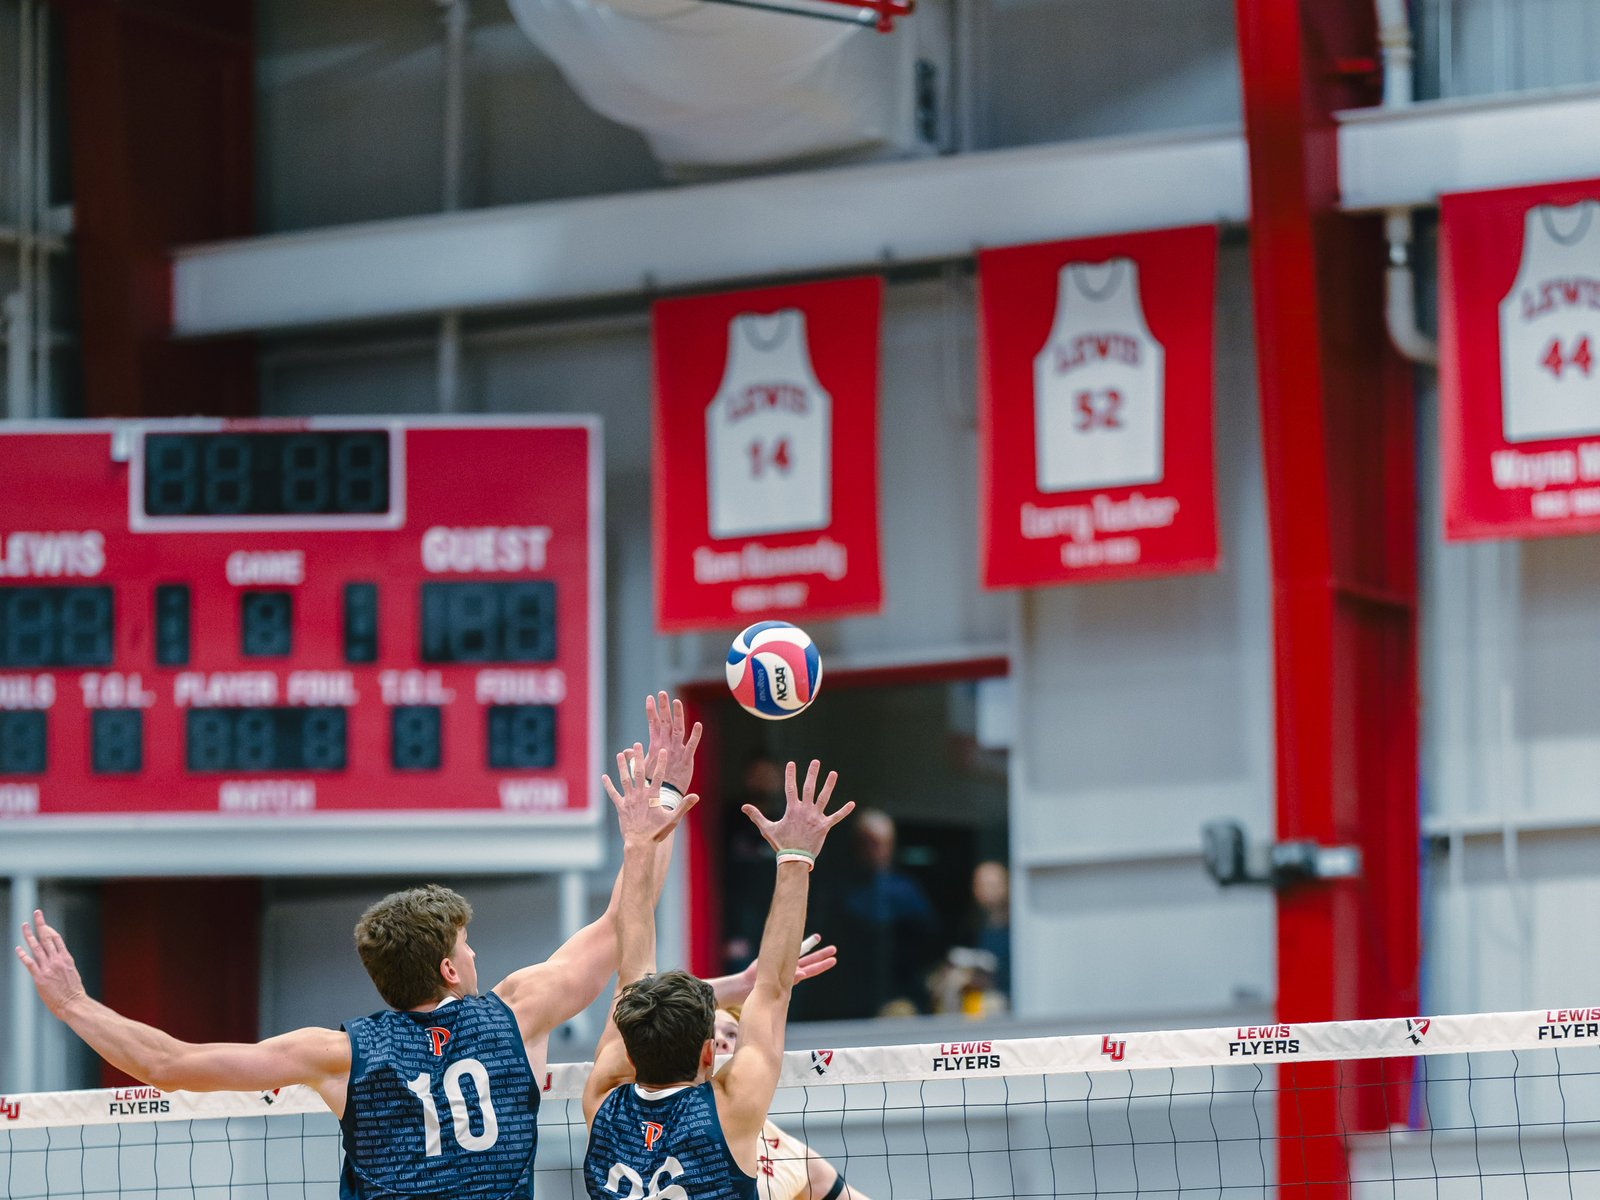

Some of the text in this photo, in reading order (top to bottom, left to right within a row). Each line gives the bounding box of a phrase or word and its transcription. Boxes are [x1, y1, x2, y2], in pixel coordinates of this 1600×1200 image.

[1055, 336, 1141, 374] LEWIS
[1541, 337, 1592, 378] 44
[727, 384, 809, 424] LEWIS
[1076, 389, 1123, 432] 52
[749, 437, 793, 480] 14
[421, 525, 551, 573] GUEST
[775, 667, 787, 701] NCAA
[1546, 1008, 1600, 1023] LEWIS
[1237, 1026, 1291, 1040] LEWIS
[1538, 1023, 1599, 1040] FLYER
[940, 1042, 992, 1056] LEWIS
[1101, 1035, 1126, 1062] LU
[1229, 1040, 1300, 1056] FLYERS
[932, 1055, 1000, 1072] FLYERS
[109, 1100, 170, 1116] FLYERS
[115, 1088, 161, 1101] LEWIS
[407, 1059, 499, 1158] 10
